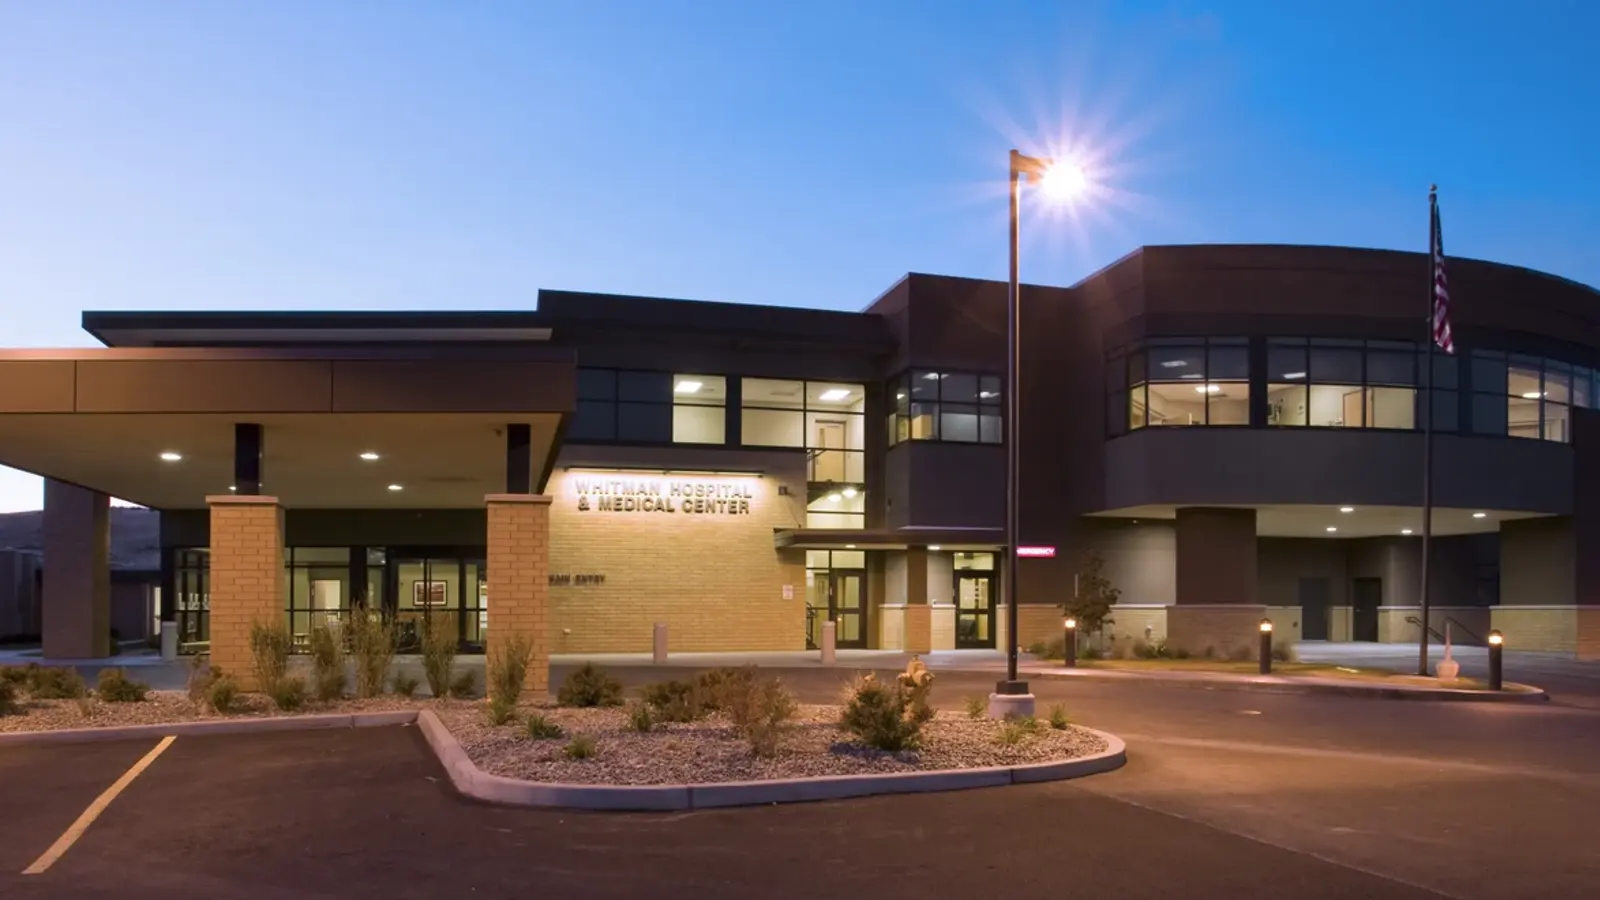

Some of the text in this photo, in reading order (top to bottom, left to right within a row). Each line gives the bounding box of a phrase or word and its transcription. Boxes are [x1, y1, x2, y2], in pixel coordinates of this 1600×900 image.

[575, 480, 753, 499] WHITMAN HOSPITAL
[577, 496, 749, 515] & MEDICAL CENTER
[574, 574, 605, 585] ENTRY
